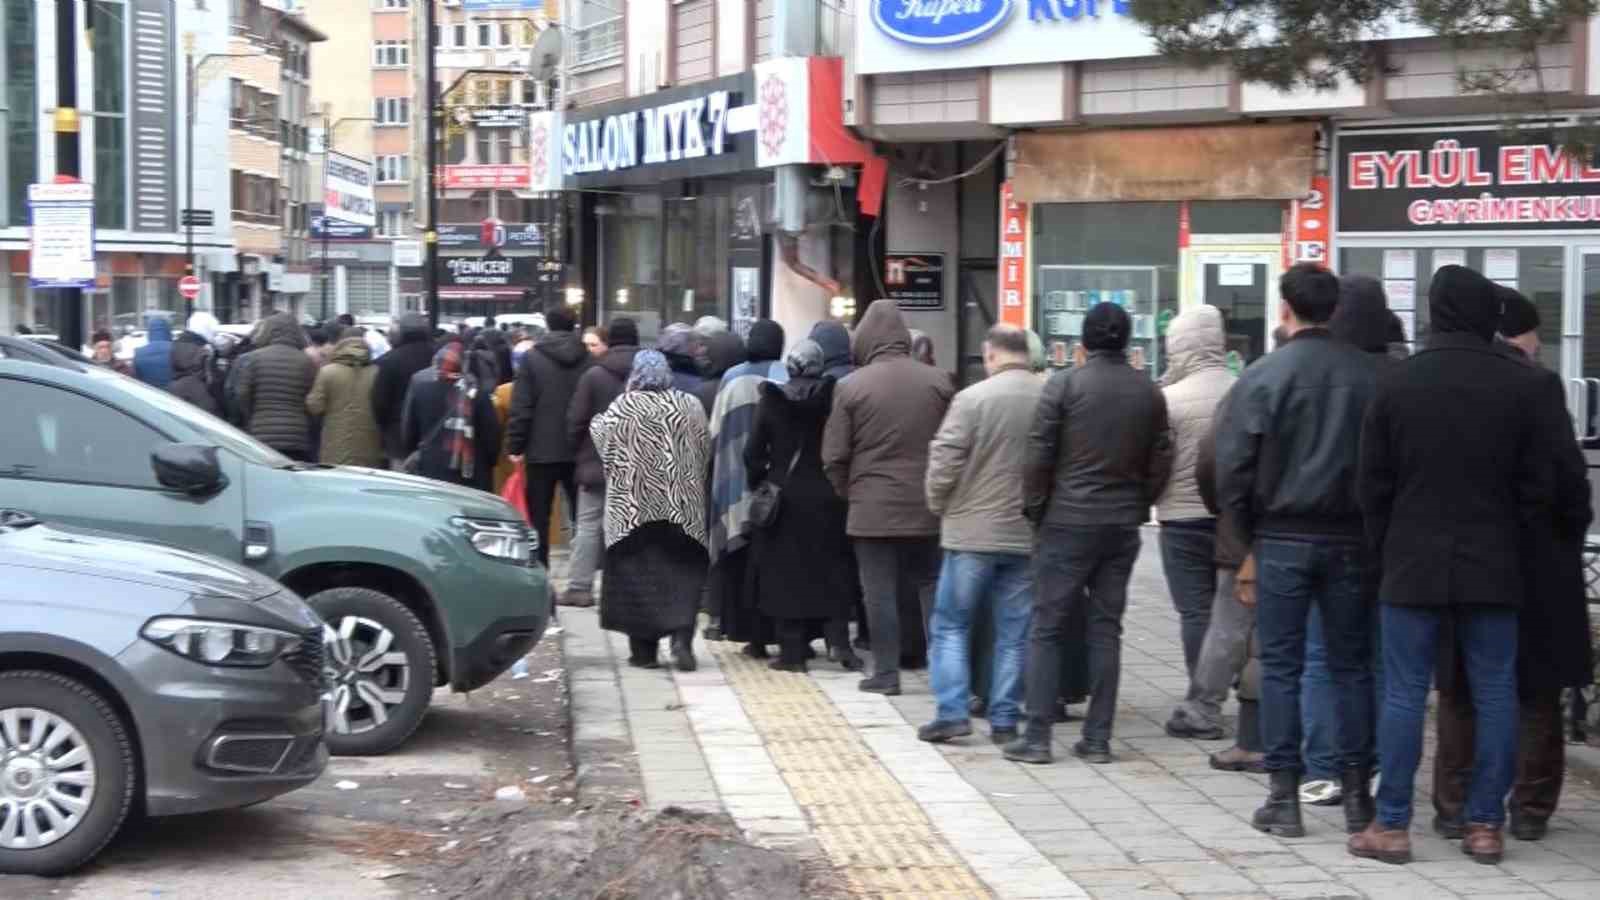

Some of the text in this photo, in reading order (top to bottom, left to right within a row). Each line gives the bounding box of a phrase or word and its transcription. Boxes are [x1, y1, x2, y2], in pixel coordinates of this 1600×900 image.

[563, 91, 727, 175] SALON MYK 7
[1349, 139, 1493, 189] EYLÜL
